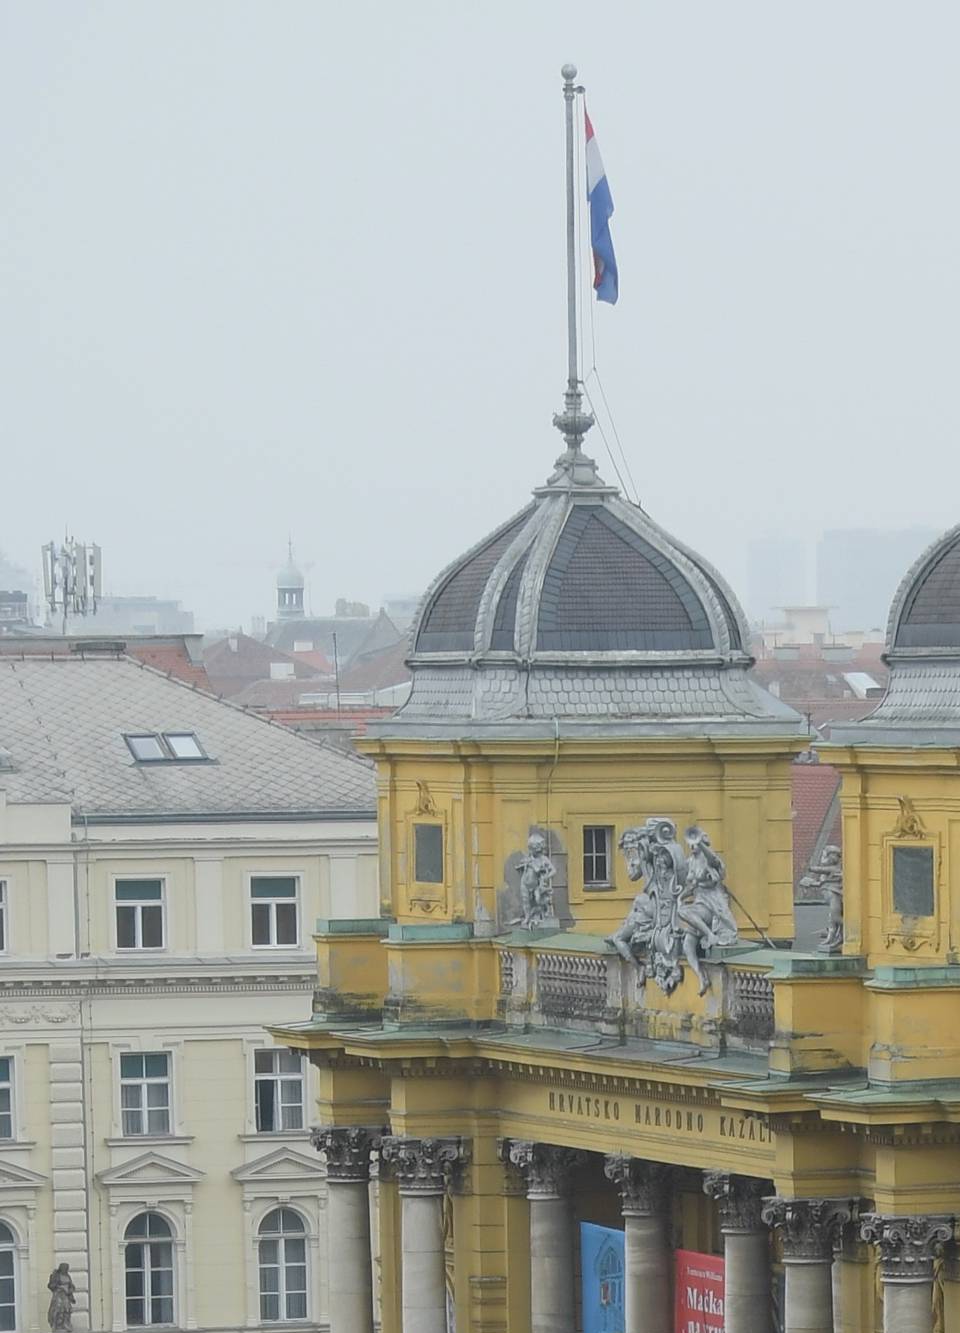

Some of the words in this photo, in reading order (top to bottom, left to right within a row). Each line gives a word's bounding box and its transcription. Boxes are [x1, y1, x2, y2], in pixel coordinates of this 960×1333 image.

[549, 1091, 620, 1120] HRVATSKO
[635, 1104, 704, 1133] NARODNO
[686, 1286, 724, 1316] Mačka
